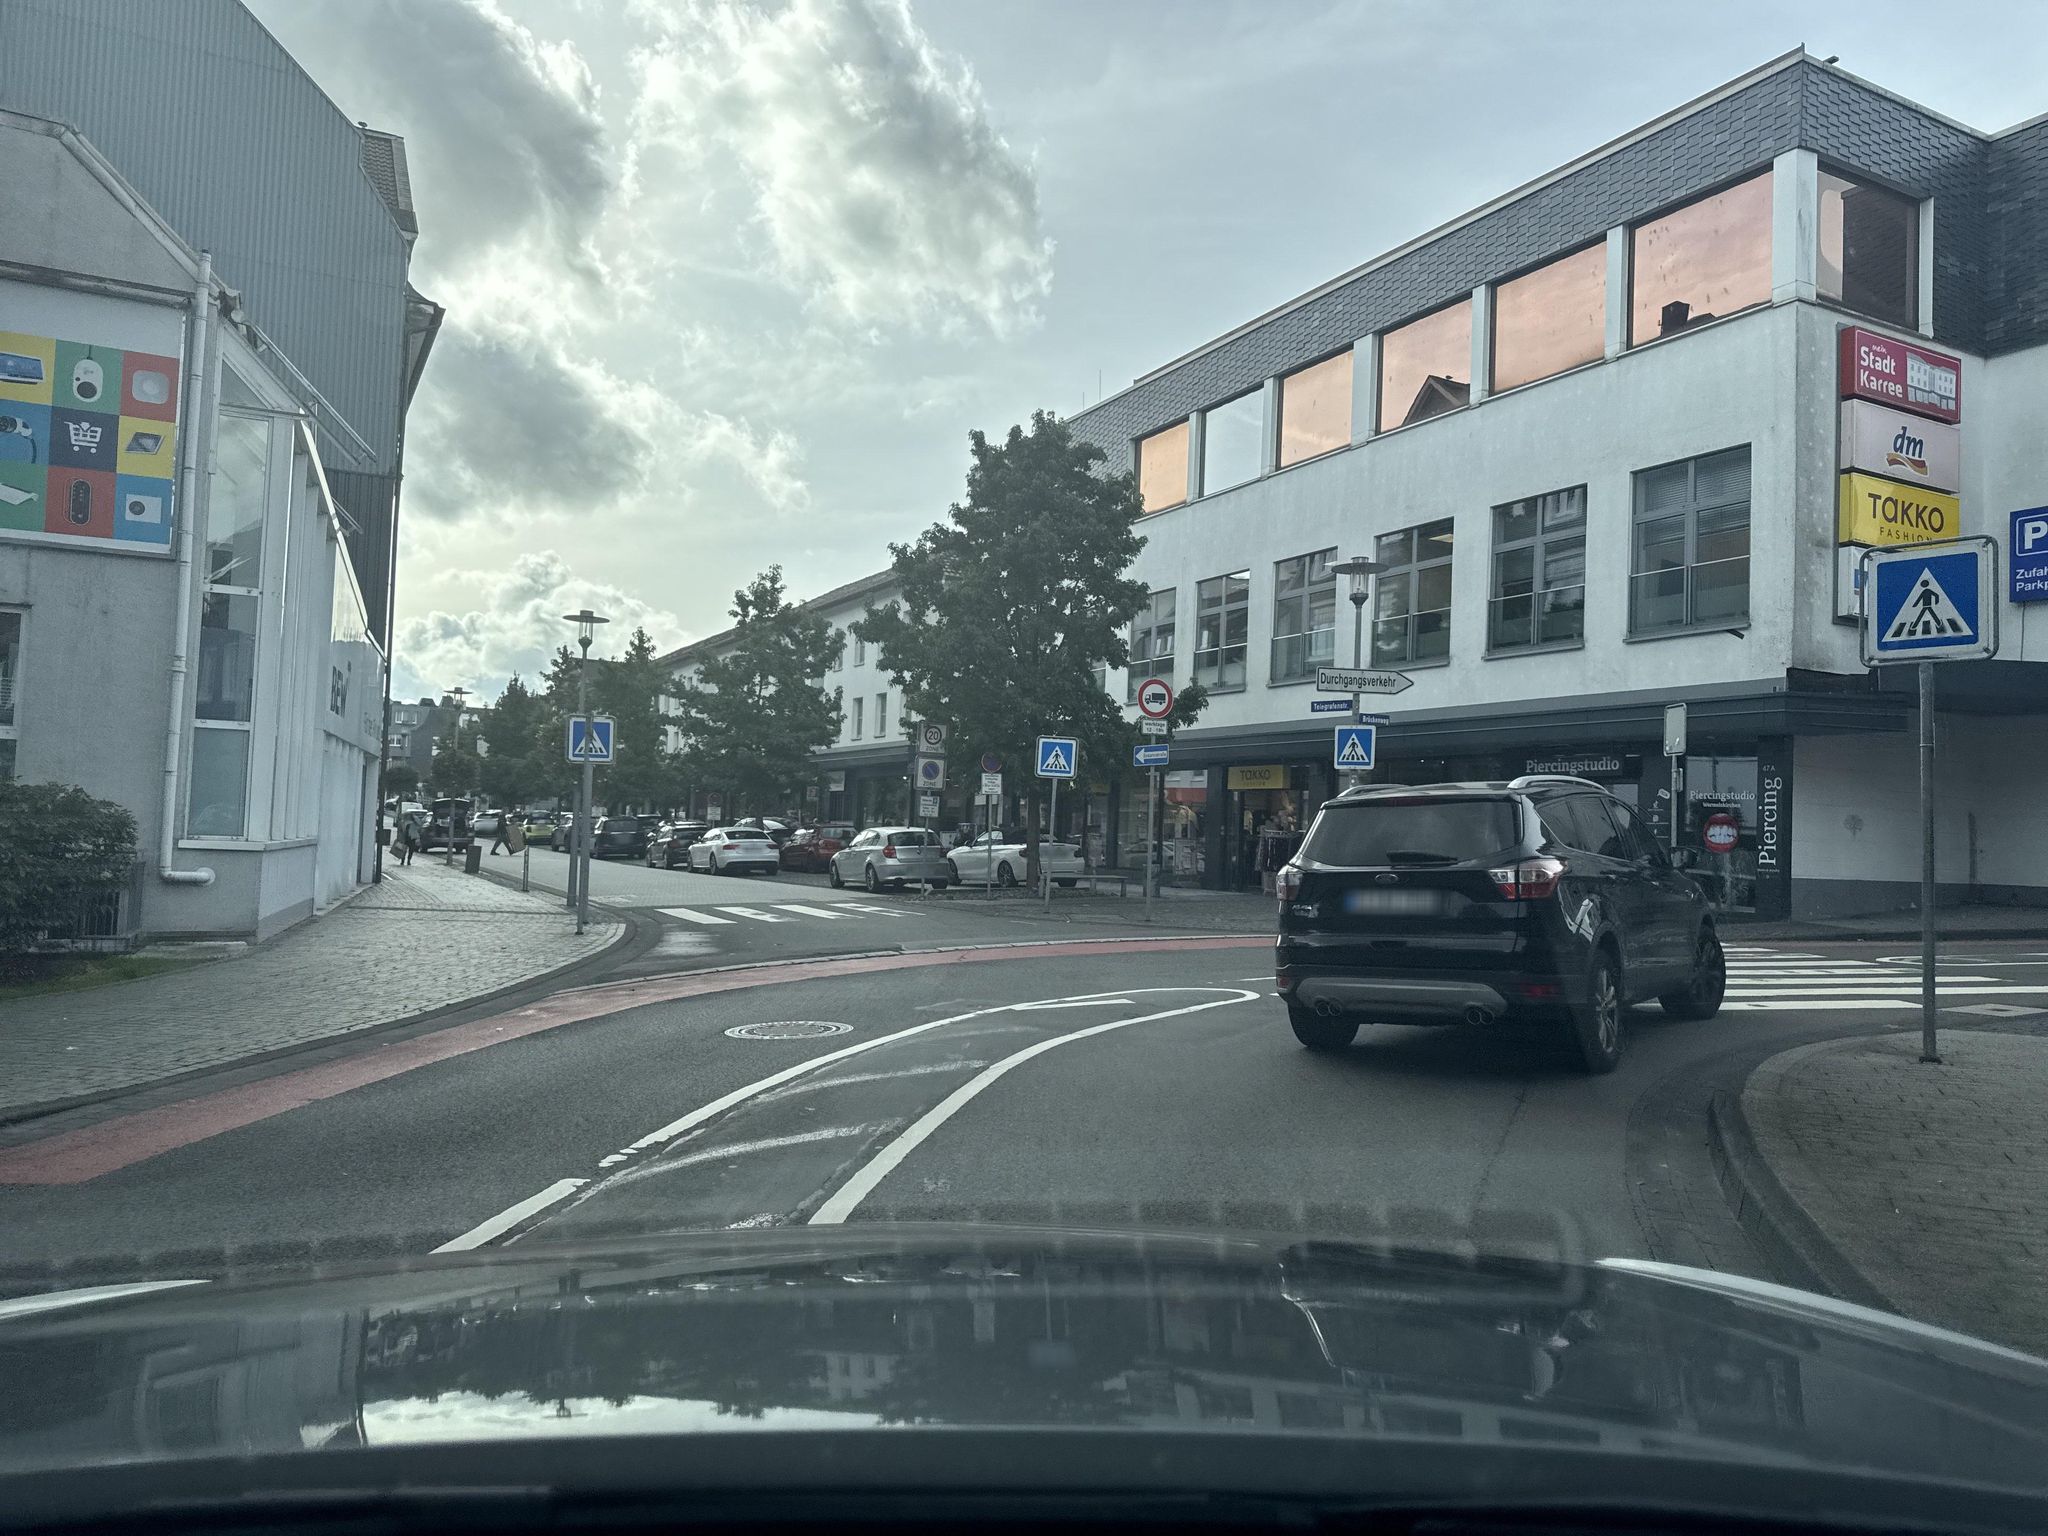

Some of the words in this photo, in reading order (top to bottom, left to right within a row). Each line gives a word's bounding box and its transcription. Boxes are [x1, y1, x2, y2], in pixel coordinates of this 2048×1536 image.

[1860, 346, 1896, 375] Stadt
[1860, 369, 1903, 398] Karree
[1893, 426, 1924, 459] dm
[2024, 521, 2048, 550] P
[1320, 672, 1396, 689] Durchgangsverkehr
[1313, 702, 1350, 711] Telegrafenstr.
[928, 730, 939, 741] 20
[1526, 757, 1619, 775] Piercingstudio
[1690, 790, 1756, 802] Piercingstudio
[1758, 777, 1782, 866] Piercing
